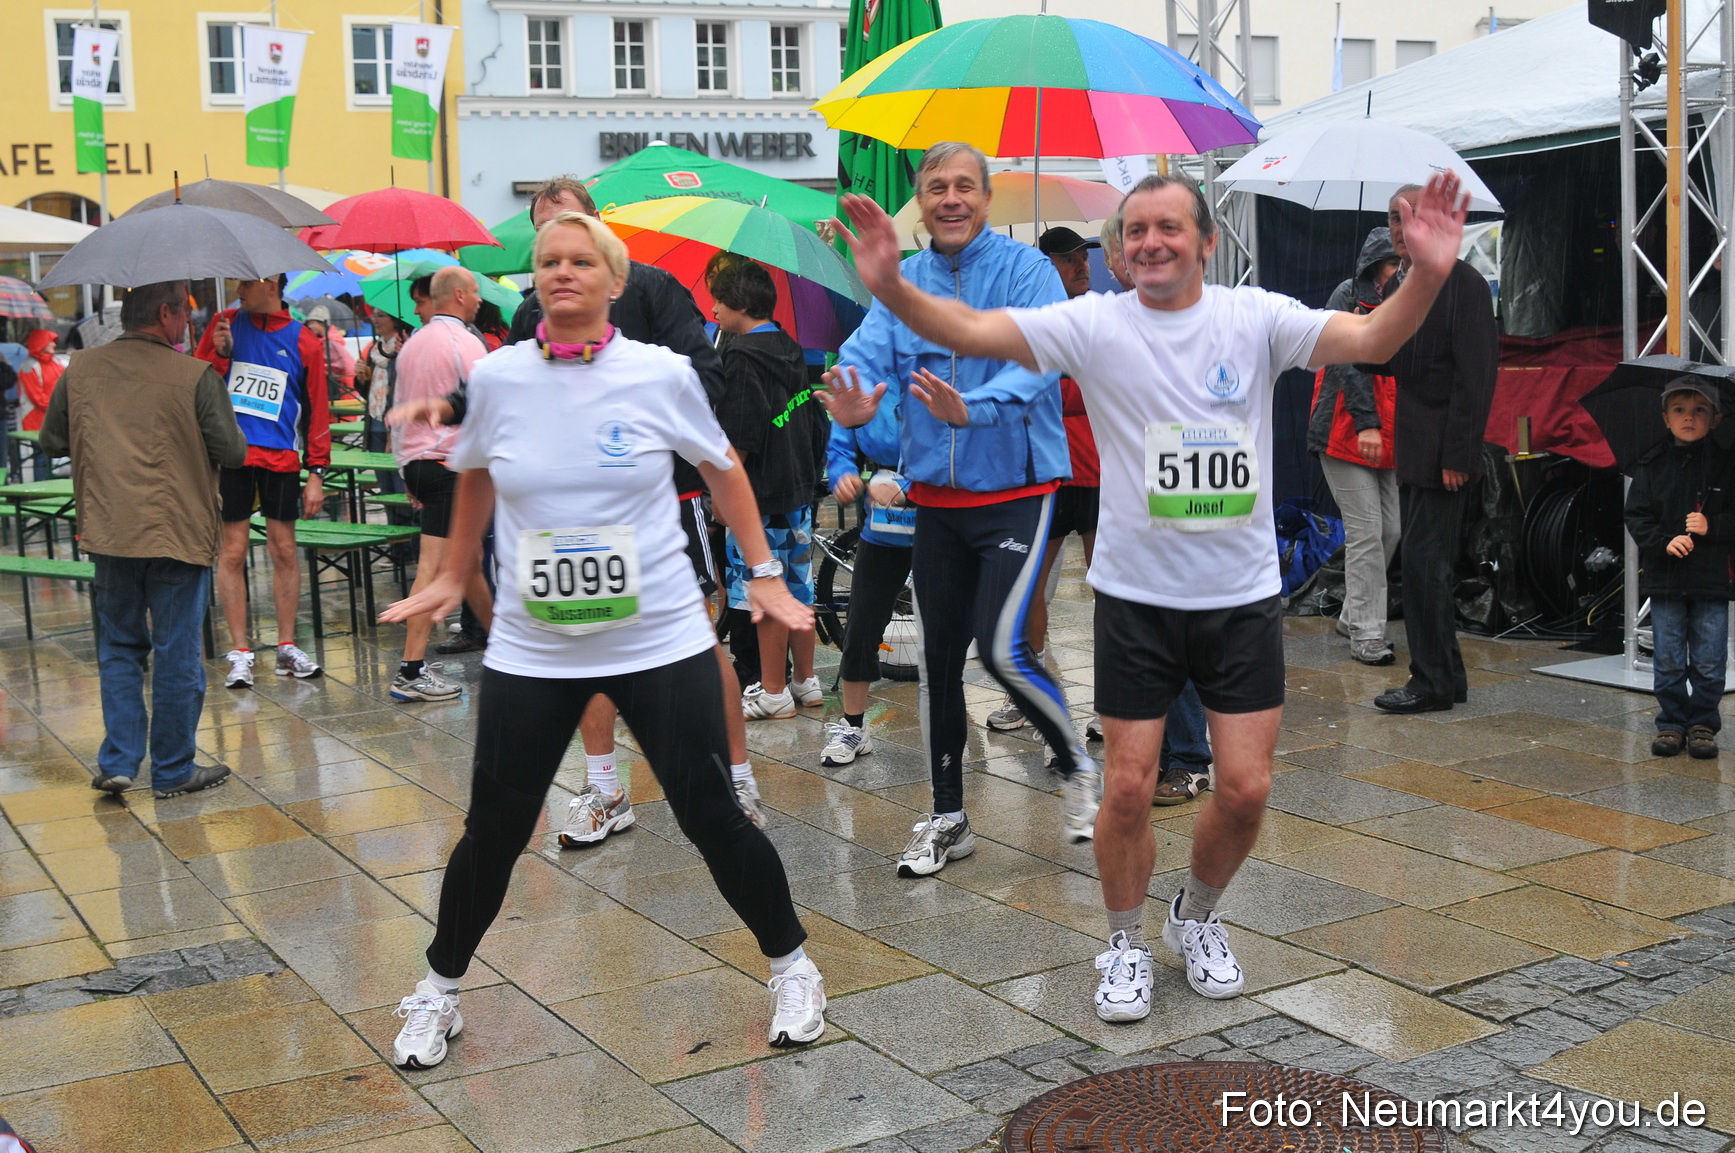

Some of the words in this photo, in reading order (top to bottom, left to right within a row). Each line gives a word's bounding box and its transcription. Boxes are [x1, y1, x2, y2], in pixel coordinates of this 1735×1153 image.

[714, 131, 817, 159] WEBER
[233, 375, 280, 401] 2705
[1158, 451, 1250, 490] 5106
[1185, 498, 1225, 515] Josef
[530, 554, 627, 598] 5099
[547, 604, 615, 621] Susanne
